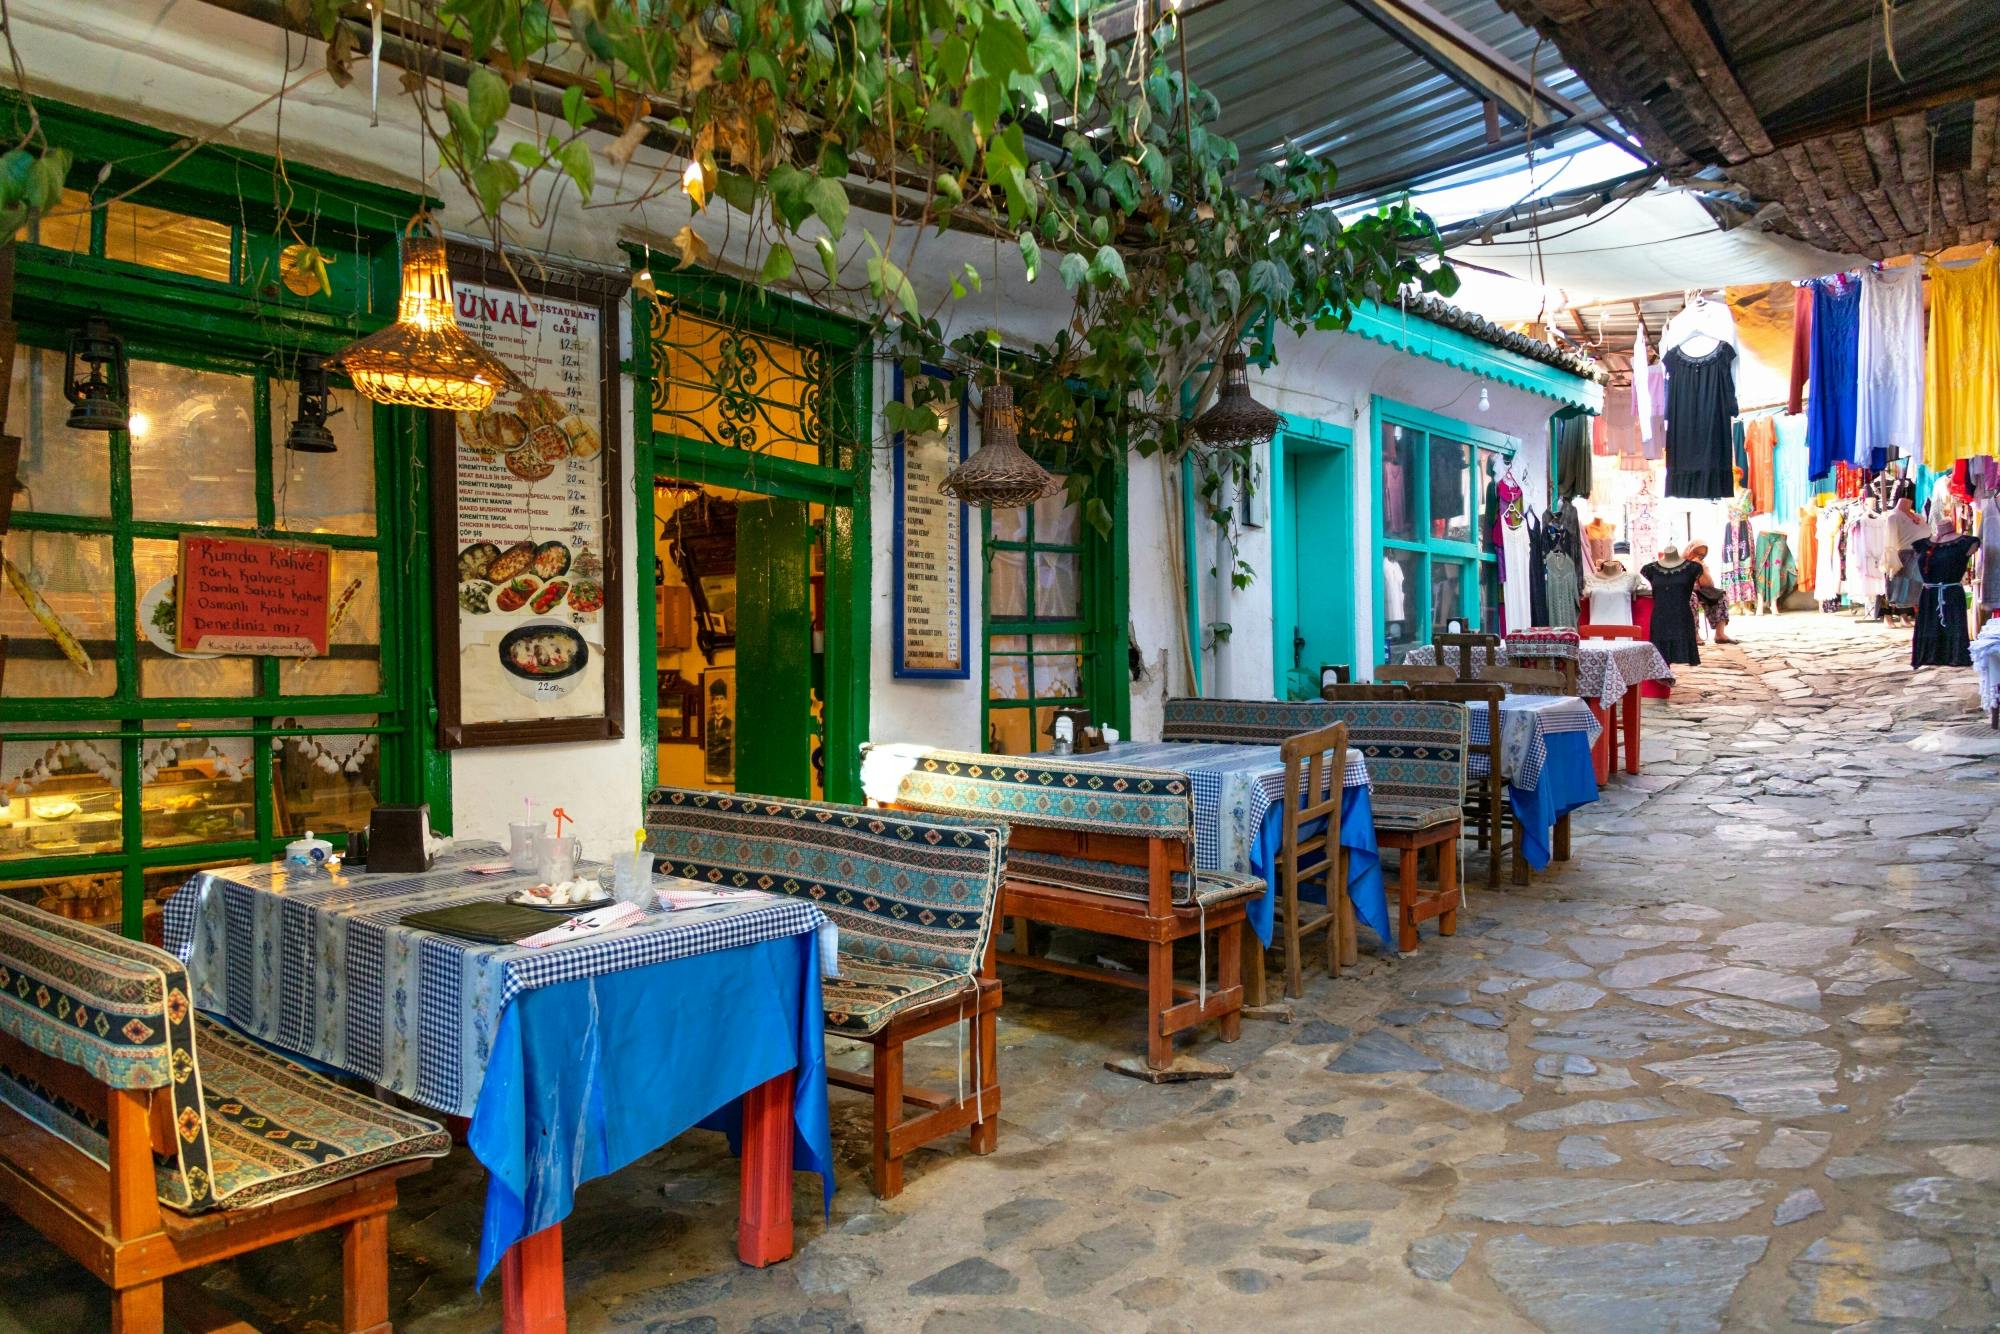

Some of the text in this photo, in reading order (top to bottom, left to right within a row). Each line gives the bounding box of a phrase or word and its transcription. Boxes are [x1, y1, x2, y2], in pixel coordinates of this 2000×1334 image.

[457, 288, 537, 328] ÜNAL
[560, 338, 573, 350] 12
[562, 355, 573, 366] 12
[489, 465, 507, 473] KÖFTE
[567, 474, 576, 483] 20
[568, 489, 579, 500] 22
[479, 506, 512, 514] MUSHROOM
[459, 521, 484, 529] CHICKEN
[459, 529, 472, 537] ÇÖP
[201, 543, 258, 563] Kumda
[199, 565, 231, 580] Türk
[199, 581, 239, 594] Damla
[193, 617, 265, 632] Denediniz
